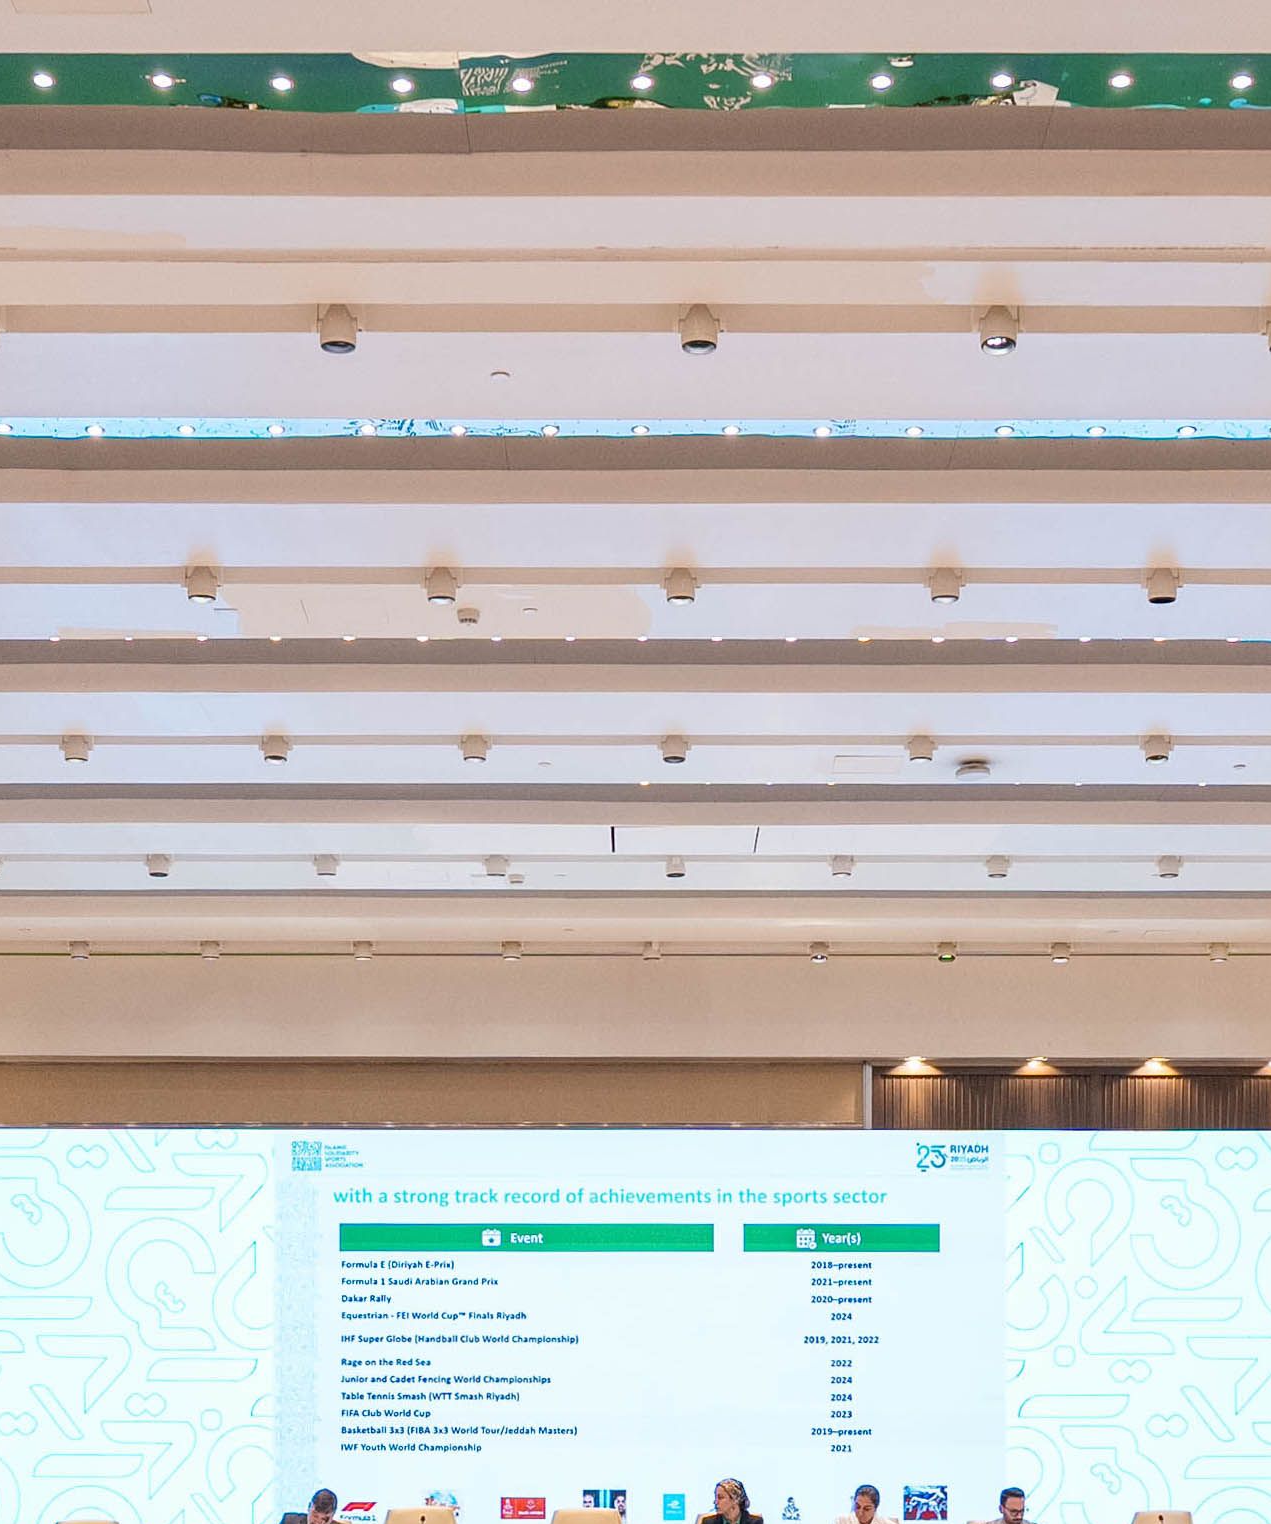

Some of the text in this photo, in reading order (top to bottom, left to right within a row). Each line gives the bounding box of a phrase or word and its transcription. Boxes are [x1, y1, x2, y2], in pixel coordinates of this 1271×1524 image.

[950, 1144, 989, 1154] RIYADH
[333, 1187, 888, 1208] with a strong track record of achievements in the sports sector
[510, 1232, 543, 1244] Event
[822, 1232, 862, 1246] Year(s)
[341, 1260, 379, 1269] Formula
[387, 1260, 424, 1270] (Diriyah
[425, 1260, 455, 1271] E-Prix)
[341, 1277, 378, 1286] Formula
[387, 1277, 413, 1286] Saudi
[414, 1277, 450, 1286] Arabian
[451, 1277, 479, 1286] Grand
[481, 1277, 499, 1286] Prix
[341, 1294, 392, 1305] Dakar Rally
[341, 1311, 389, 1321] Equestrian
[396, 1311, 410, 1320] FEI
[411, 1311, 439, 1320] World
[468, 1311, 494, 1320] Finals
[496, 1311, 527, 1321] Riyadh
[830, 1312, 853, 1321] 2024
[340, 1334, 579, 1345] IHF Super Globe (Handball Club World Championship)
[803, 1335, 880, 1345] 2019, 2021, 2022
[340, 1357, 363, 1368] Rage
[378, 1358, 394, 1366] the
[395, 1358, 414, 1366] Red
[414, 1358, 432, 1367] Sea
[830, 1359, 853, 1368] 2022
[340, 1375, 552, 1385] Junior and Cadet Fencing World Championships
[830, 1376, 853, 1385] 2024
[340, 1391, 520, 1402] Table Tennis Smash (WTT Smash Riyadh)
[830, 1393, 853, 1402] 2024
[341, 1409, 432, 1419] FIFA Club World Cup
[830, 1410, 853, 1419] 2023
[340, 1425, 578, 1436] Basketball 3x3 (FIBA 3x3 World Tour/Jeddah Masters)
[340, 1443, 482, 1453] IWF Youth World Championship
[830, 1444, 852, 1453] 2021
